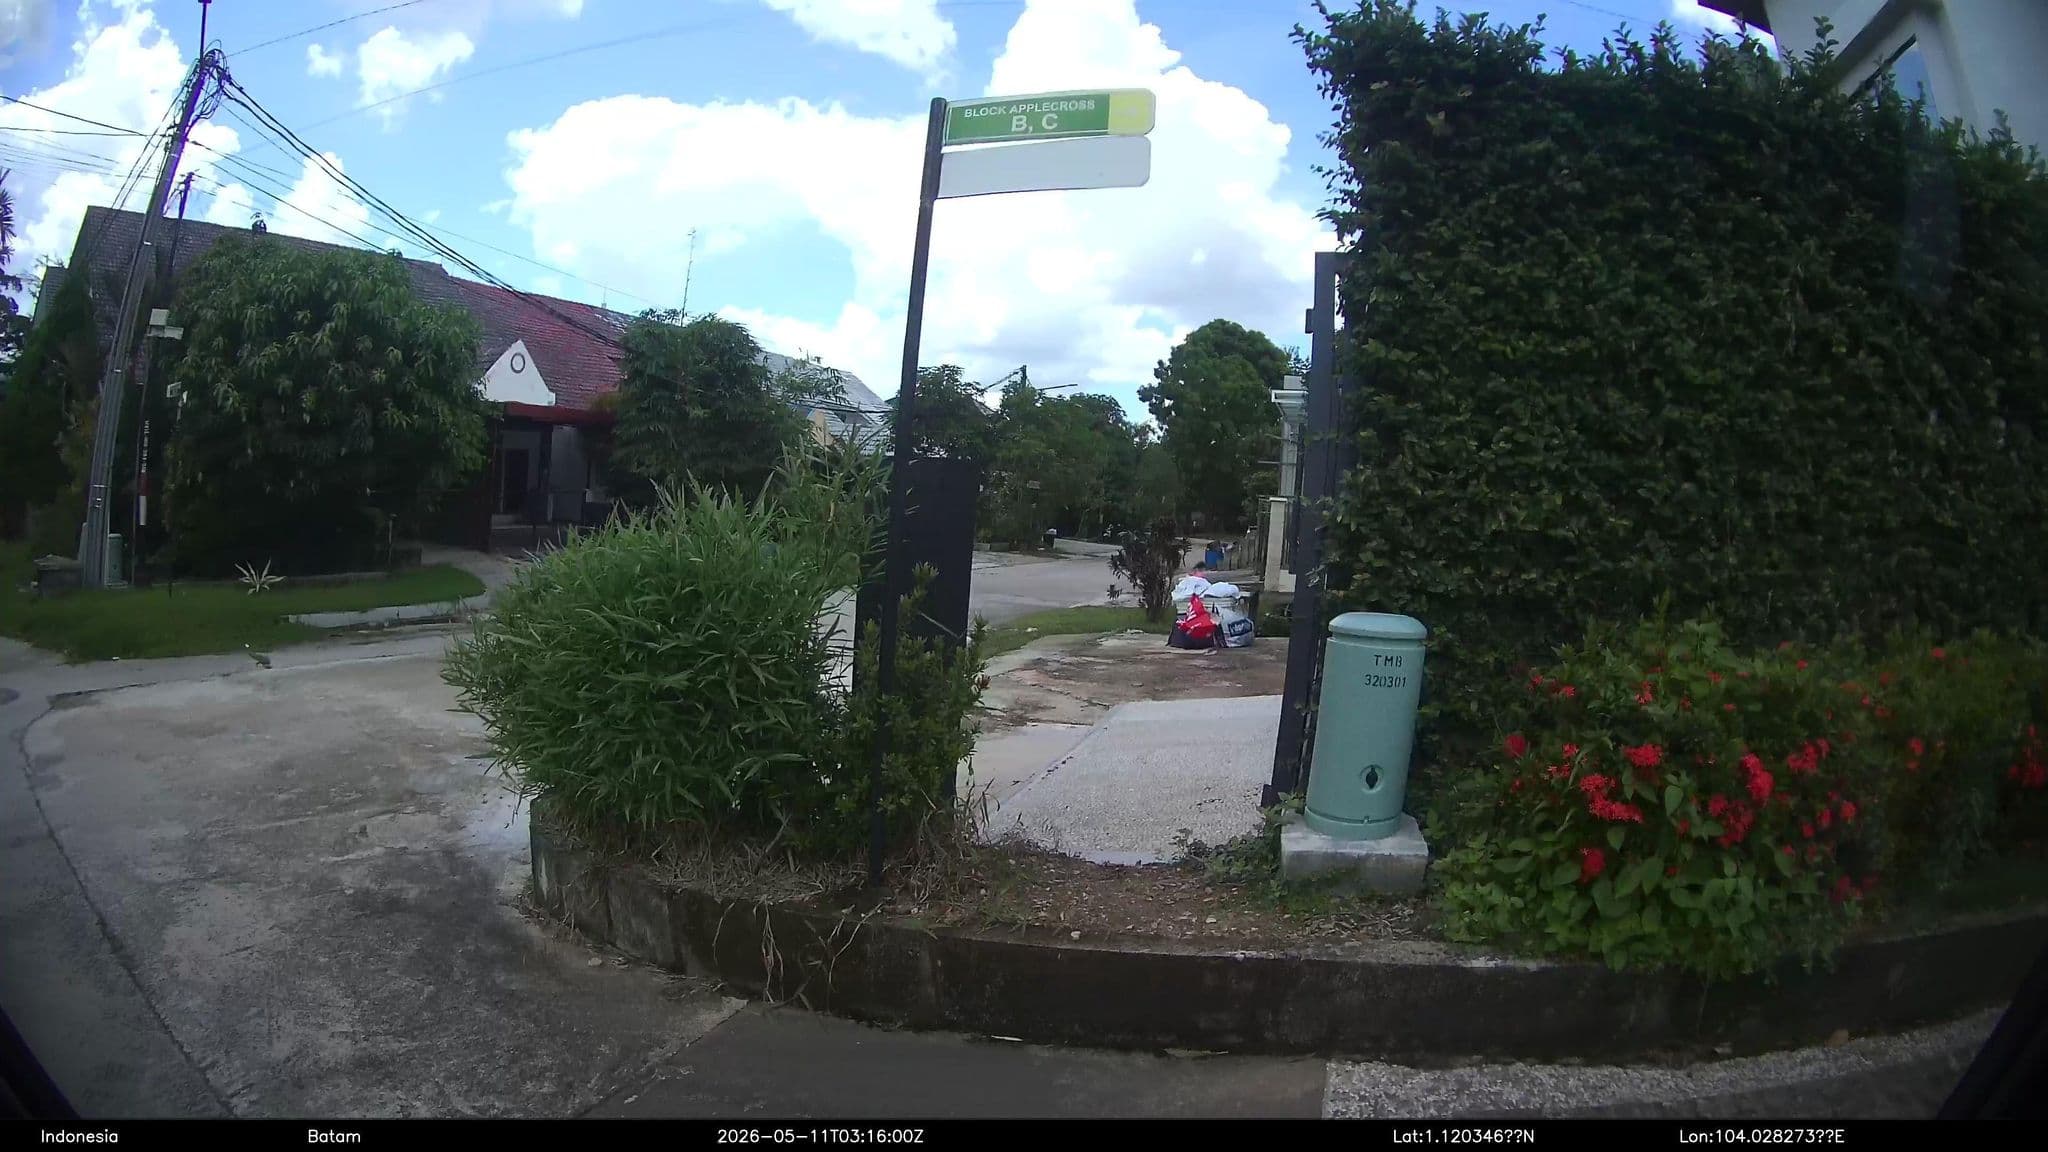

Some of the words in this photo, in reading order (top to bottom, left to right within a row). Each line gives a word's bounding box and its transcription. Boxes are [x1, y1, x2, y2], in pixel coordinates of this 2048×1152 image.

[964, 106, 1007, 118] BLOCK
[1009, 99, 1096, 114] APPLECROSS
[1011, 114, 1033, 134] B,
[1041, 113, 1059, 130] C
[1373, 654, 1403, 668] TMB
[1364, 674, 1407, 688] 320301
